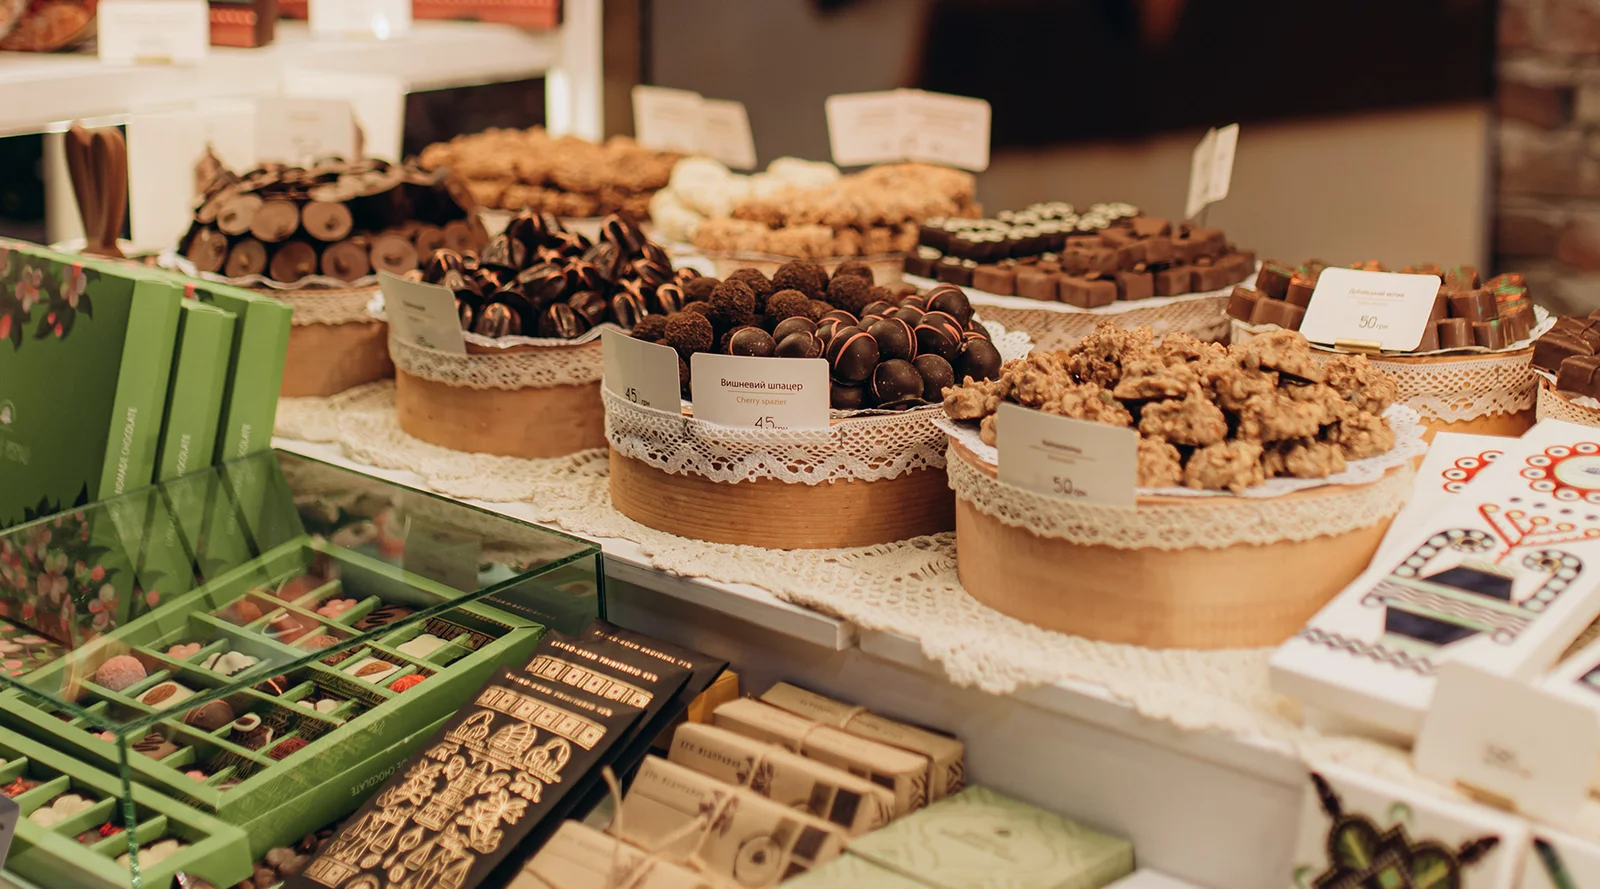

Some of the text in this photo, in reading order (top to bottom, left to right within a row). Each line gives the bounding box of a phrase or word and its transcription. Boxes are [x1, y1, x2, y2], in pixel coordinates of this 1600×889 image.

[1359, 315, 1377, 329] 50
[720, 378, 804, 392] Вишневий шпацер
[625, 387, 638, 404] 45
[736, 396, 788, 406] Cherry spazier
[121, 406, 138, 456] CHOCOLATE
[754, 416, 775, 430] 45
[1052, 476, 1073, 495] 50
[599, 655, 642, 677] TRINITARIO
[350, 766, 396, 797] CHOCOLATE
